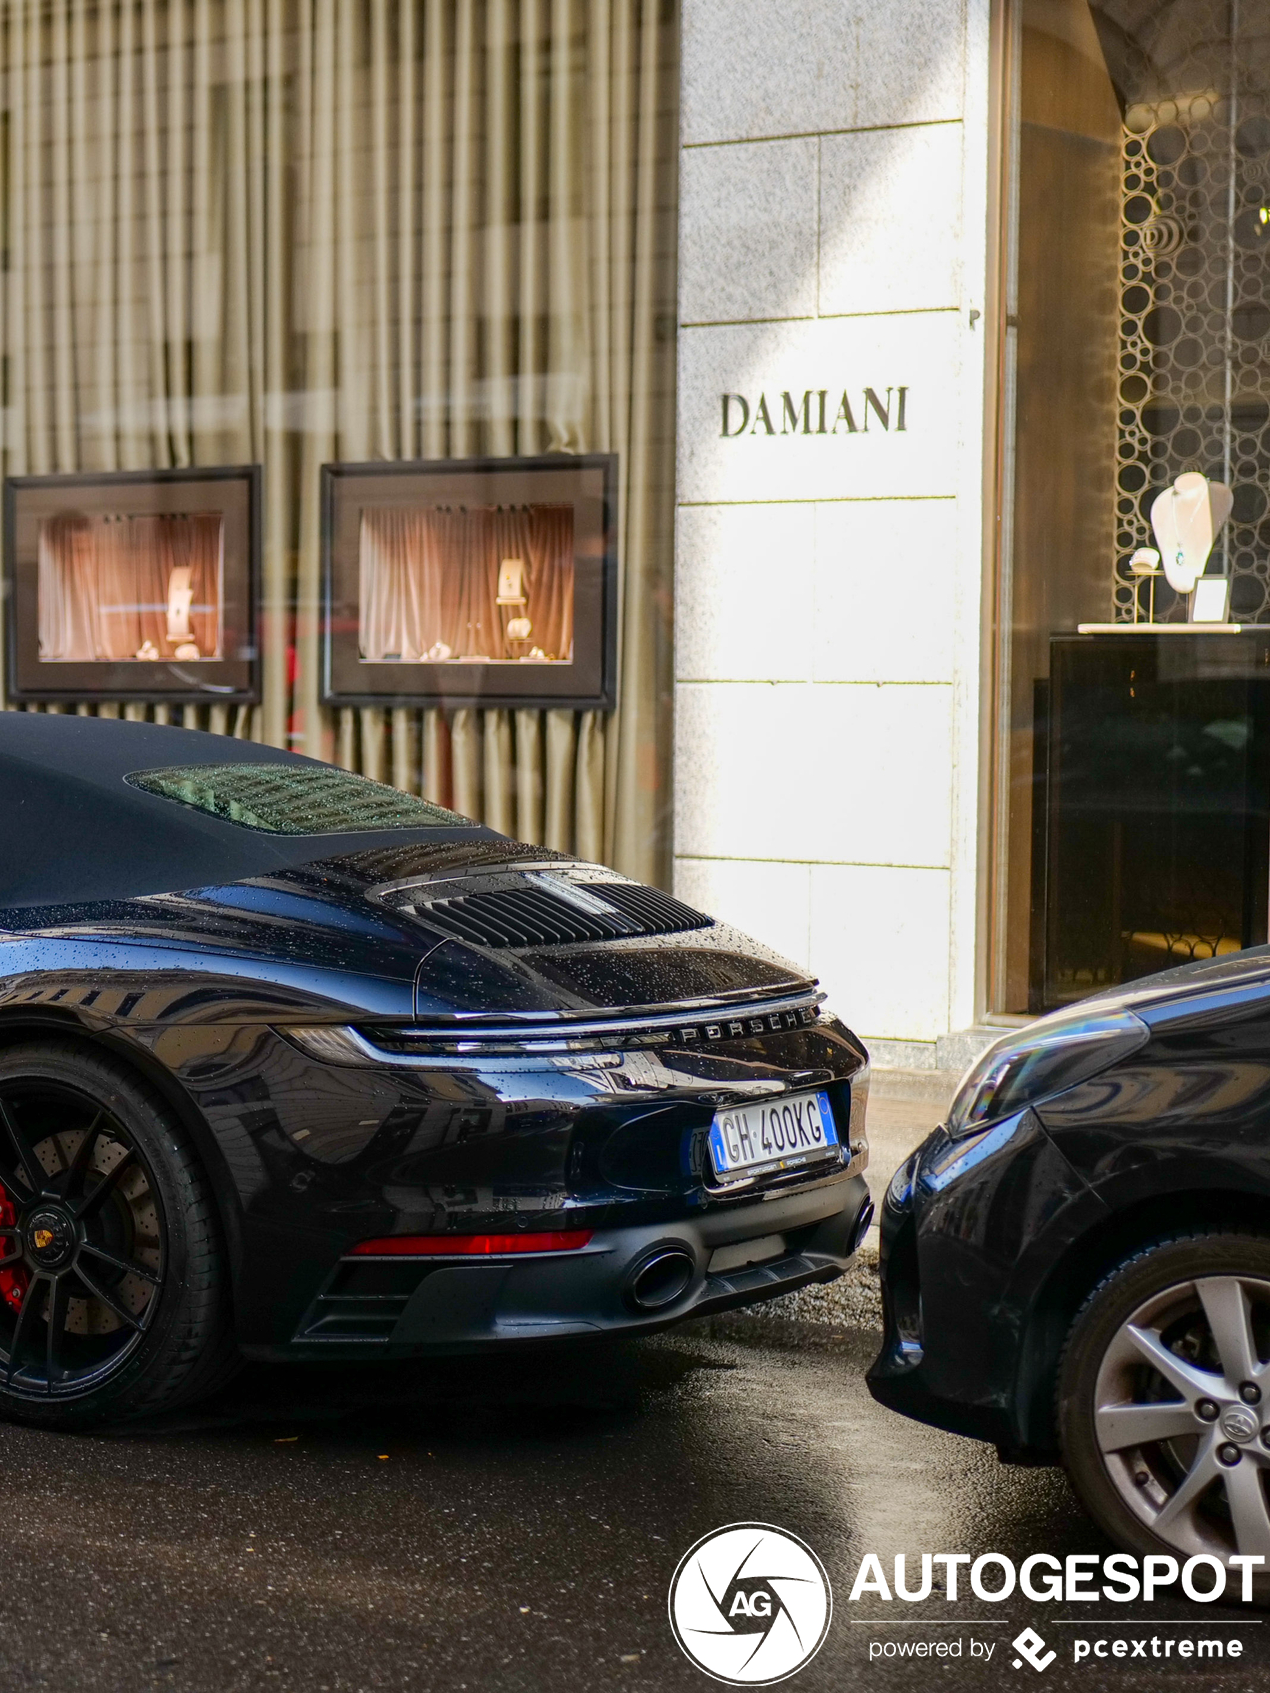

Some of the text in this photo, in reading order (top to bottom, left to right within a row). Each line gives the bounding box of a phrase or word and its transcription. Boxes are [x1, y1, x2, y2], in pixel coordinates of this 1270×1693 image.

[719, 386, 909, 438] DAMIANI
[680, 1008, 814, 1043] PORSCHE
[723, 1113, 754, 1163] GH
[761, 1100, 822, 1155] 400KG
